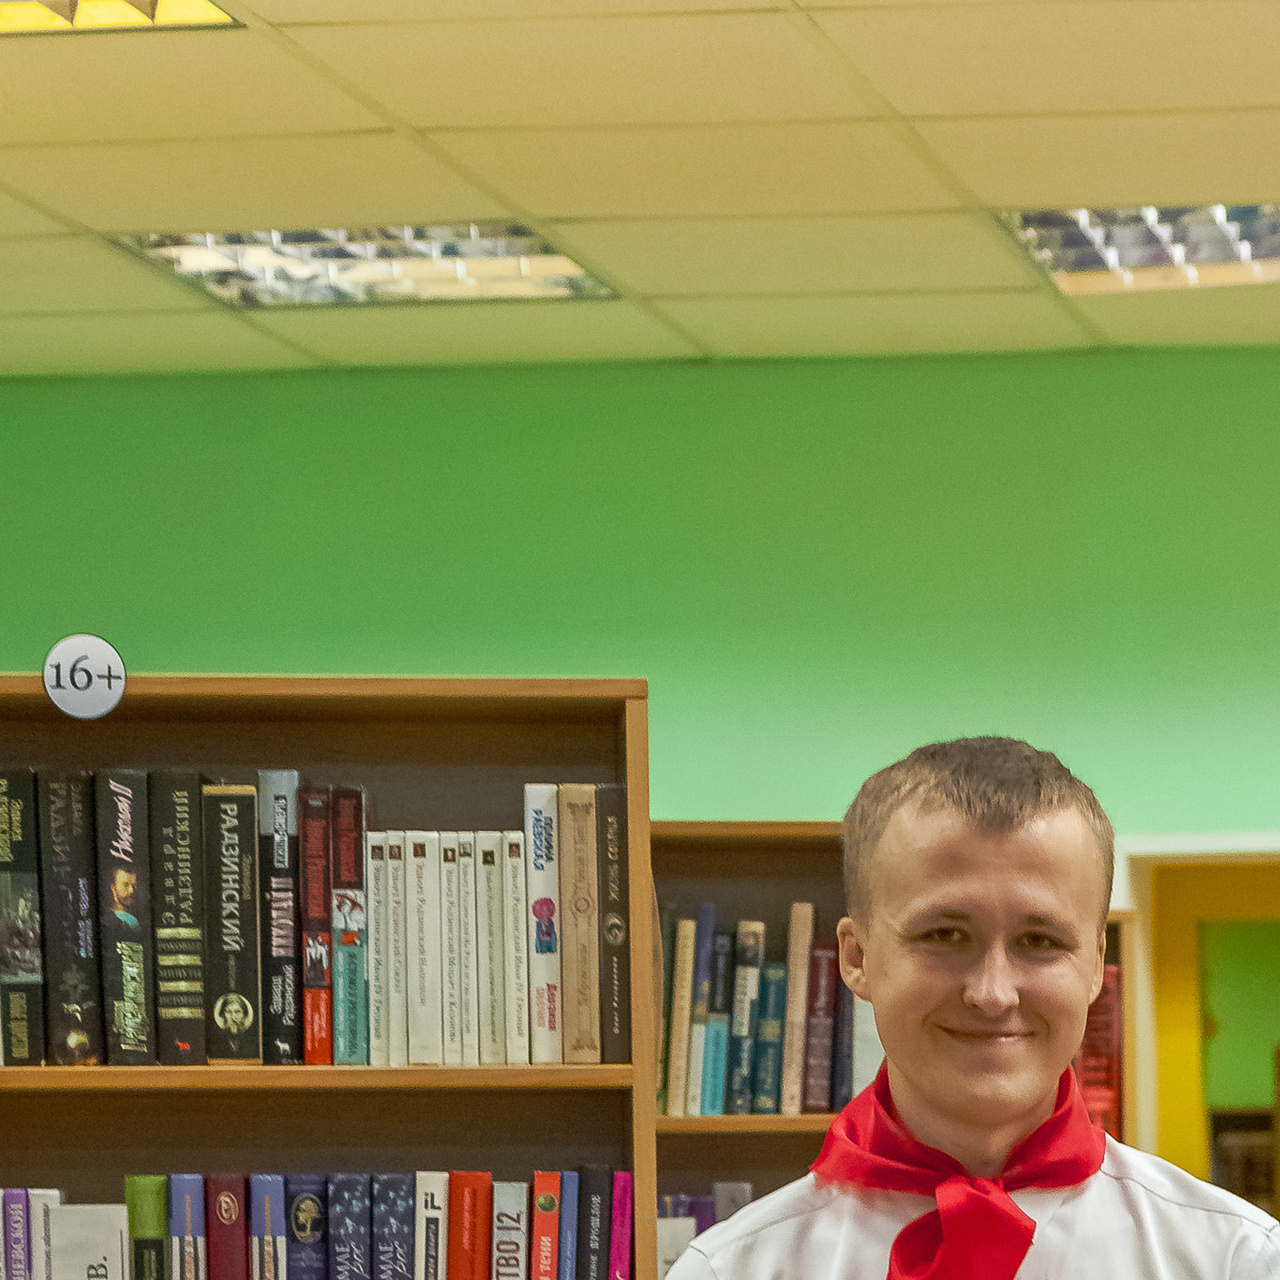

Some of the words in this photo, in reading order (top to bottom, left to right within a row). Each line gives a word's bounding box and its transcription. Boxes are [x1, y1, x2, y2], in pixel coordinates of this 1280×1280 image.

[49, 656, 123, 693] 16+
[173, 789, 193, 924] РАДЗИНСКИЙ
[161, 826, 176, 925] Эдвард
[220, 802, 244, 952] РАДЗИНСКИЙ
[495, 1211, 521, 1232] 12
[85, 1255, 108, 1280] В.
[537, 1235, 551, 1272] тени
